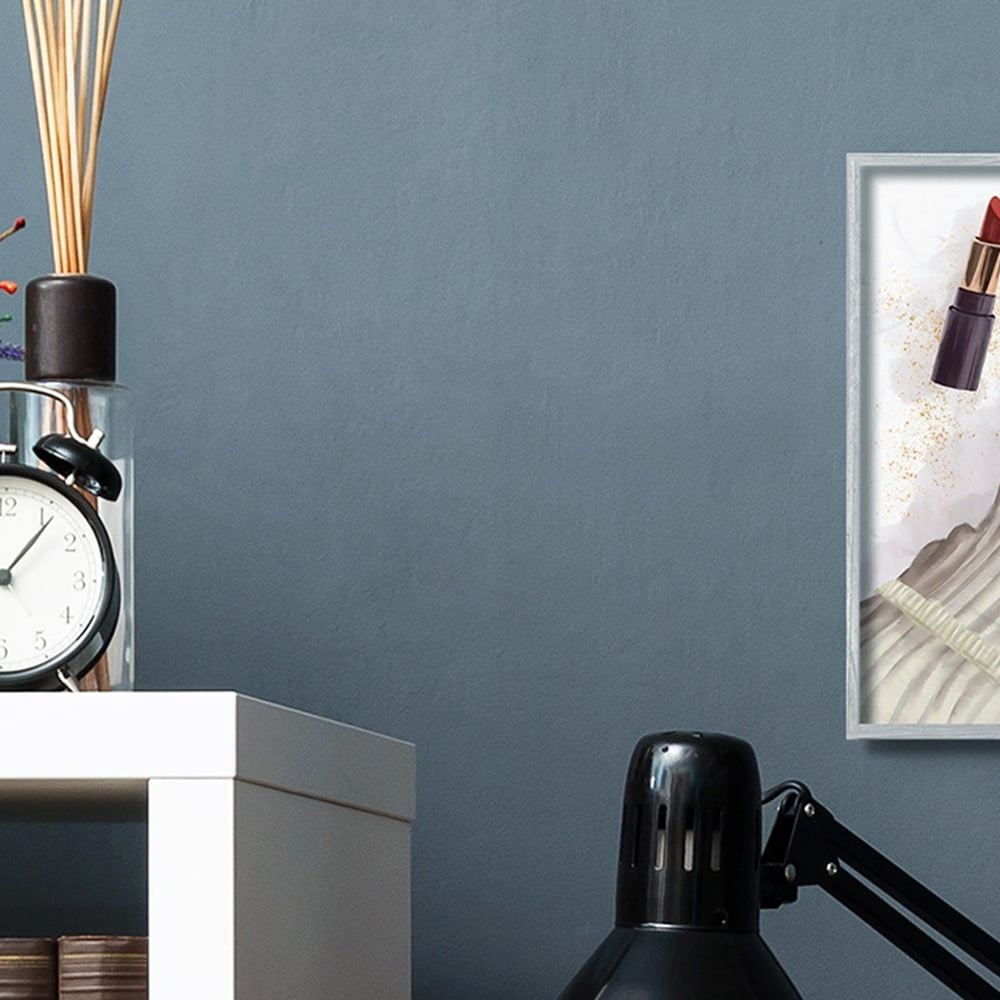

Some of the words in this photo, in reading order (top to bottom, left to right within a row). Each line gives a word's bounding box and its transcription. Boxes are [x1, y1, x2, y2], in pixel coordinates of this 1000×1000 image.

[64, 532, 77, 552] 2
[73, 570, 86, 591] 3
[60, 606, 74, 624] 4
[35, 630, 47, 651] 5
